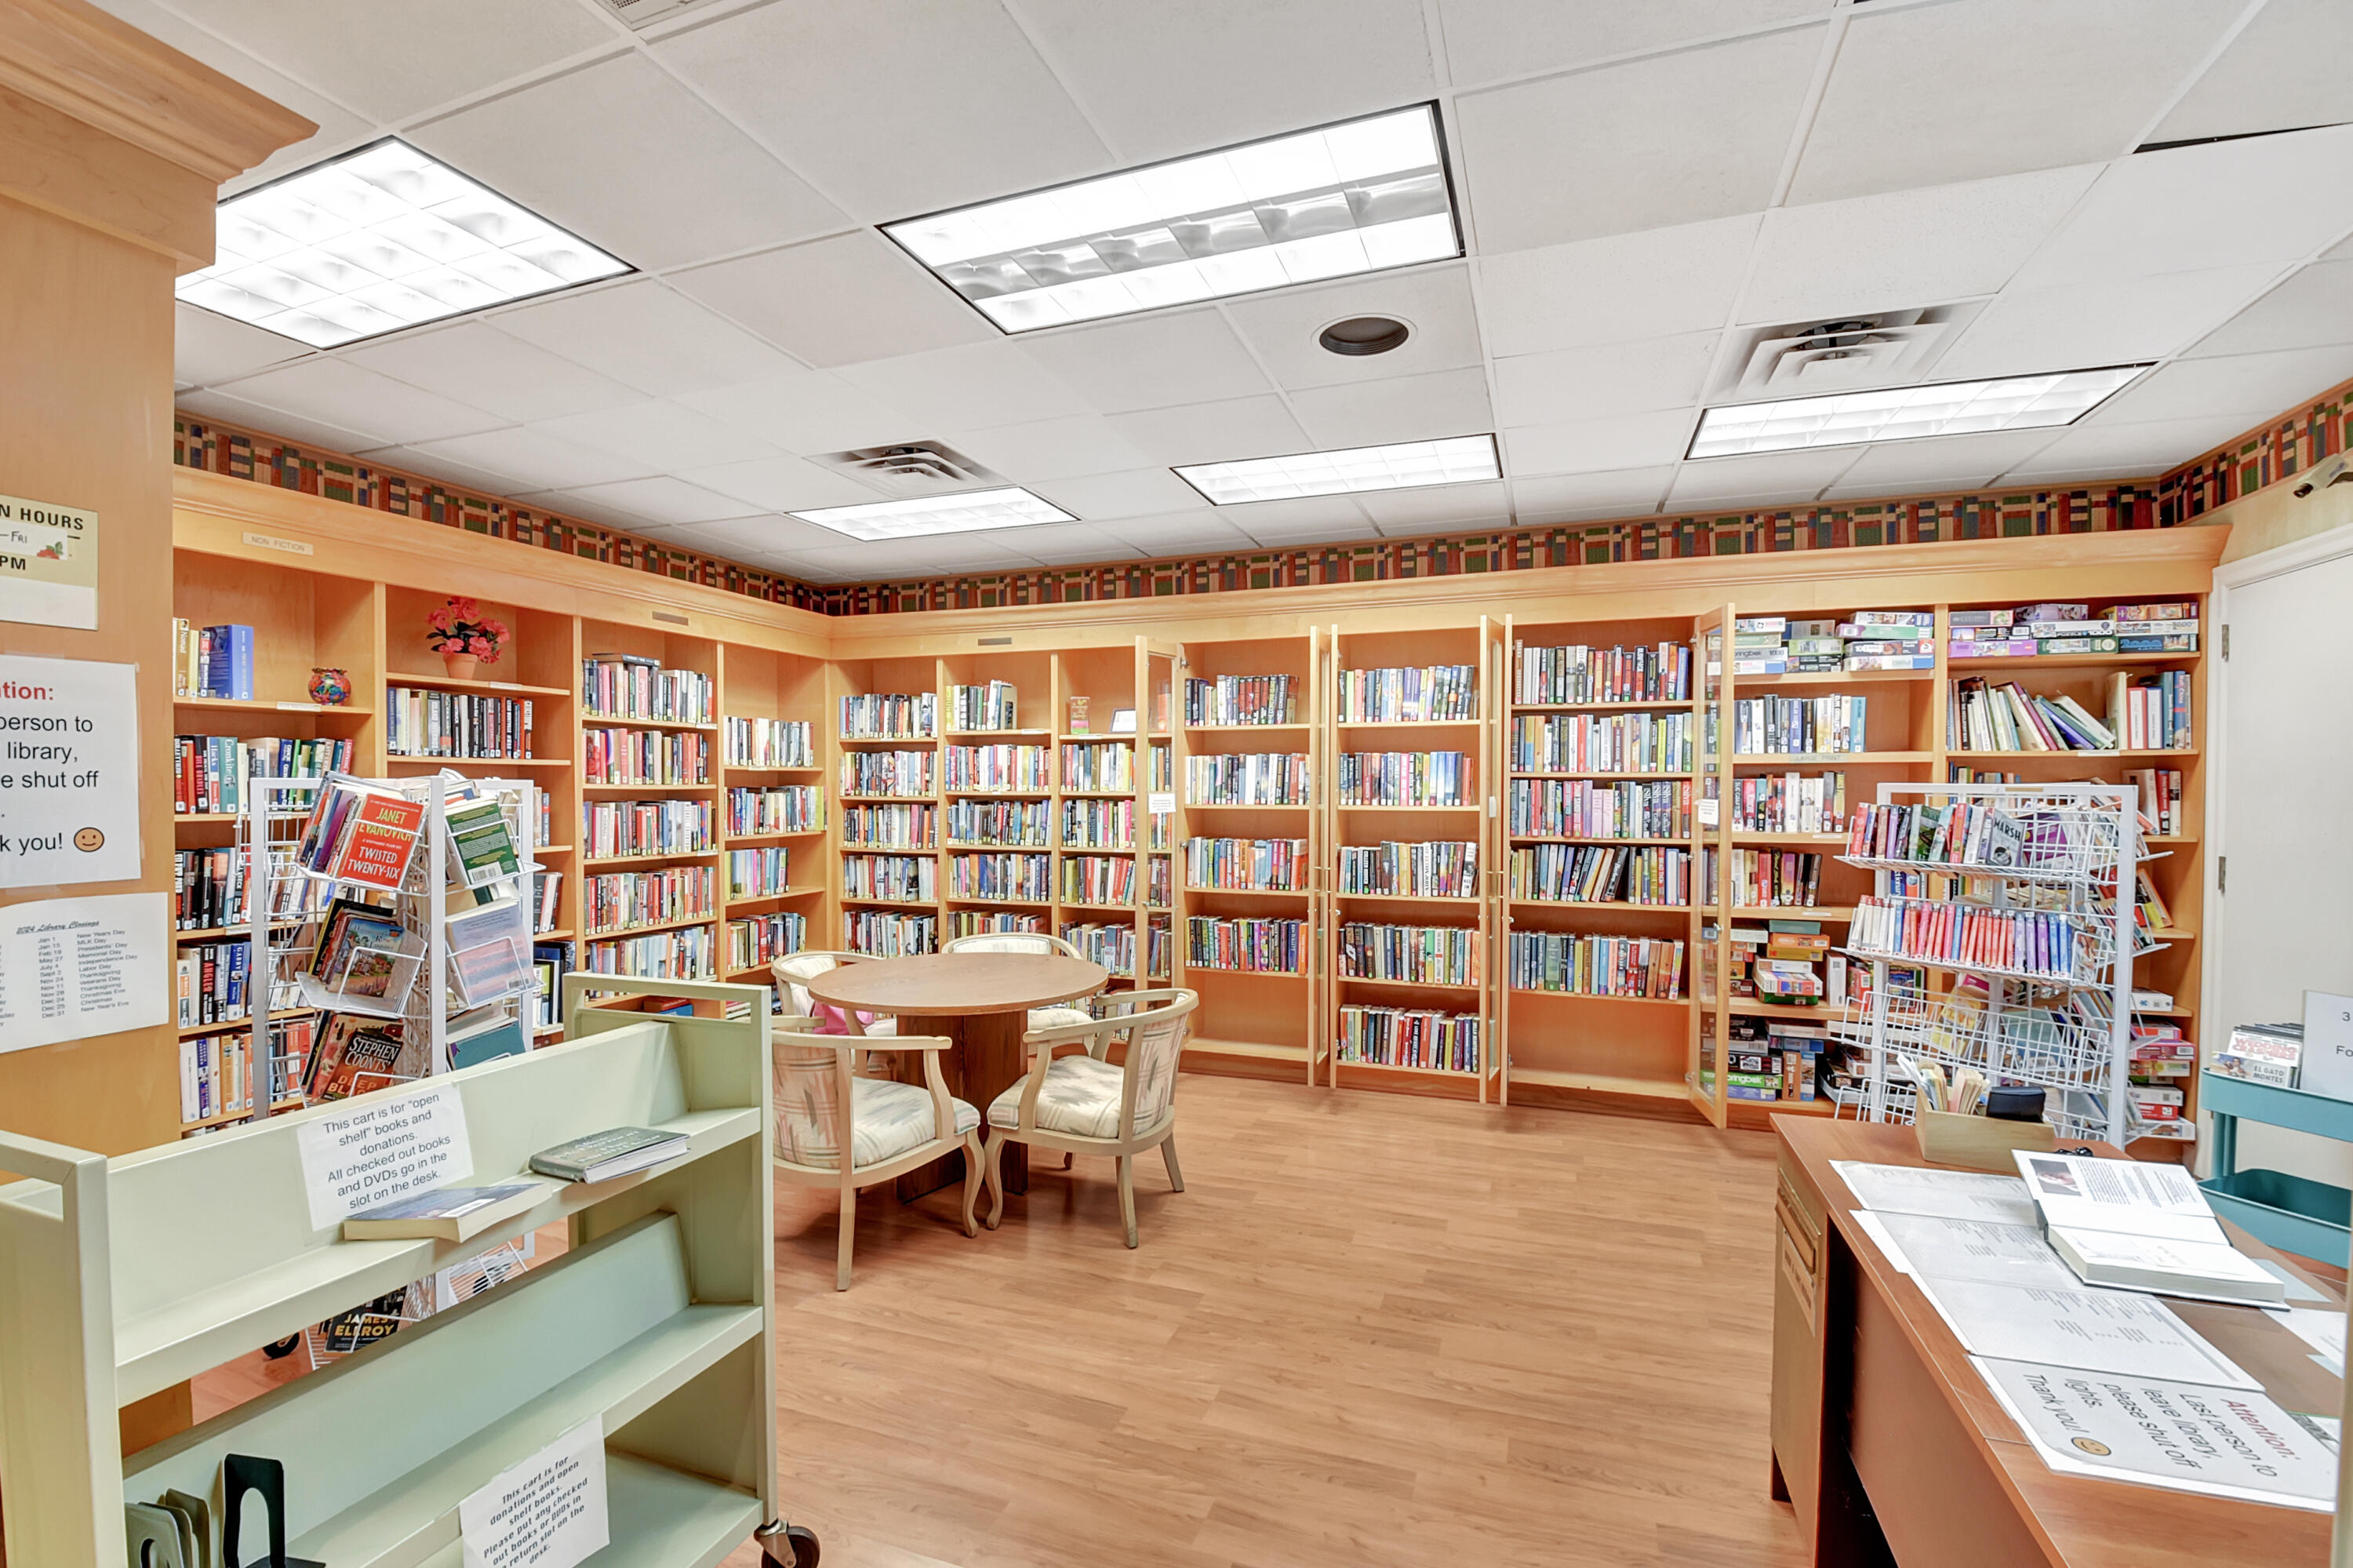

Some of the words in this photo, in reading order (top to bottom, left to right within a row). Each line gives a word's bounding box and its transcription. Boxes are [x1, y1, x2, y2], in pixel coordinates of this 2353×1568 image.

[20, 508, 84, 530] HOURS
[252, 537, 269, 545] NON
[274, 540, 304, 551] FICTION
[75, 715, 93, 732] to
[7, 742, 78, 764] library,
[225, 740, 235, 773] Cronkite
[21, 771, 67, 788] shut
[73, 770, 100, 788] off
[376, 807, 408, 824] JANET
[1994, 817, 2021, 841] MARSH
[19, 832, 63, 857] you!
[359, 846, 398, 864] TWISTED
[347, 859, 401, 879] TWENTY-SIX
[37, 924, 66, 933] Library
[203, 962, 213, 992] ANGLER
[2342, 1012, 2351, 1021] 3
[349, 1037, 398, 1060] STEPHEN
[2264, 1067, 2284, 1077] GATO
[323, 1119, 350, 1133] This
[353, 1112, 375, 1126] cart
[379, 1107, 388, 1119] is
[391, 1103, 406, 1114] for
[375, 1118, 409, 1136] books
[412, 1110, 431, 1123] and
[359, 1131, 418, 1156] donations.
[328, 1169, 343, 1183] All
[347, 1155, 395, 1177] checked
[398, 1147, 416, 1159] out
[419, 1136, 451, 1153] books
[338, 1181, 360, 1196] and
[364, 1170, 398, 1188] DVDs
[401, 1163, 415, 1177] go
[418, 1159, 427, 1169] in
[431, 1151, 447, 1164] the
[349, 1194, 371, 1209] slot
[374, 1189, 388, 1200] on
[392, 1179, 409, 1194] the
[413, 1170, 442, 1187] desk.
[334, 1325, 395, 1337] ELLROY
[2023, 1374, 2064, 1406] Thank
[2064, 1378, 2103, 1408] lights.
[2179, 1393, 2221, 1418] Last
[2042, 1406, 2090, 1433] you!
[2096, 1382, 2148, 1420] please
[2139, 1421, 2181, 1449] shut
[2165, 1450, 2203, 1470] off
[2140, 1388, 2181, 1418] leave
[2171, 1419, 2223, 1459] library,
[2220, 1398, 2302, 1461] Attention:
[2198, 1417, 2261, 1461] person
[502, 1490, 520, 1504] This
[523, 1473, 542, 1490] cart
[544, 1467, 552, 1477] is
[555, 1456, 569, 1469] for
[2251, 1464, 2278, 1477] to
[490, 1490, 536, 1526] donations
[539, 1476, 555, 1492] and
[558, 1461, 580, 1479] open
[509, 1504, 533, 1526] shelf
[535, 1486, 563, 1508] books.
[483, 1531, 515, 1559] Please
[517, 1517, 533, 1537] put
[535, 1505, 551, 1520] any
[553, 1478, 589, 1507] checked
[493, 1549, 508, 1566] out
[511, 1529, 537, 1552] books
[540, 1518, 550, 1529] or
[552, 1503, 570, 1522] DVDs
[573, 1495, 581, 1504] in
[509, 1542, 538, 1567] return
[540, 1525, 556, 1543] slot
[558, 1518, 569, 1529] on
[570, 1504, 585, 1519] the
[529, 1544, 551, 1565] desk.
